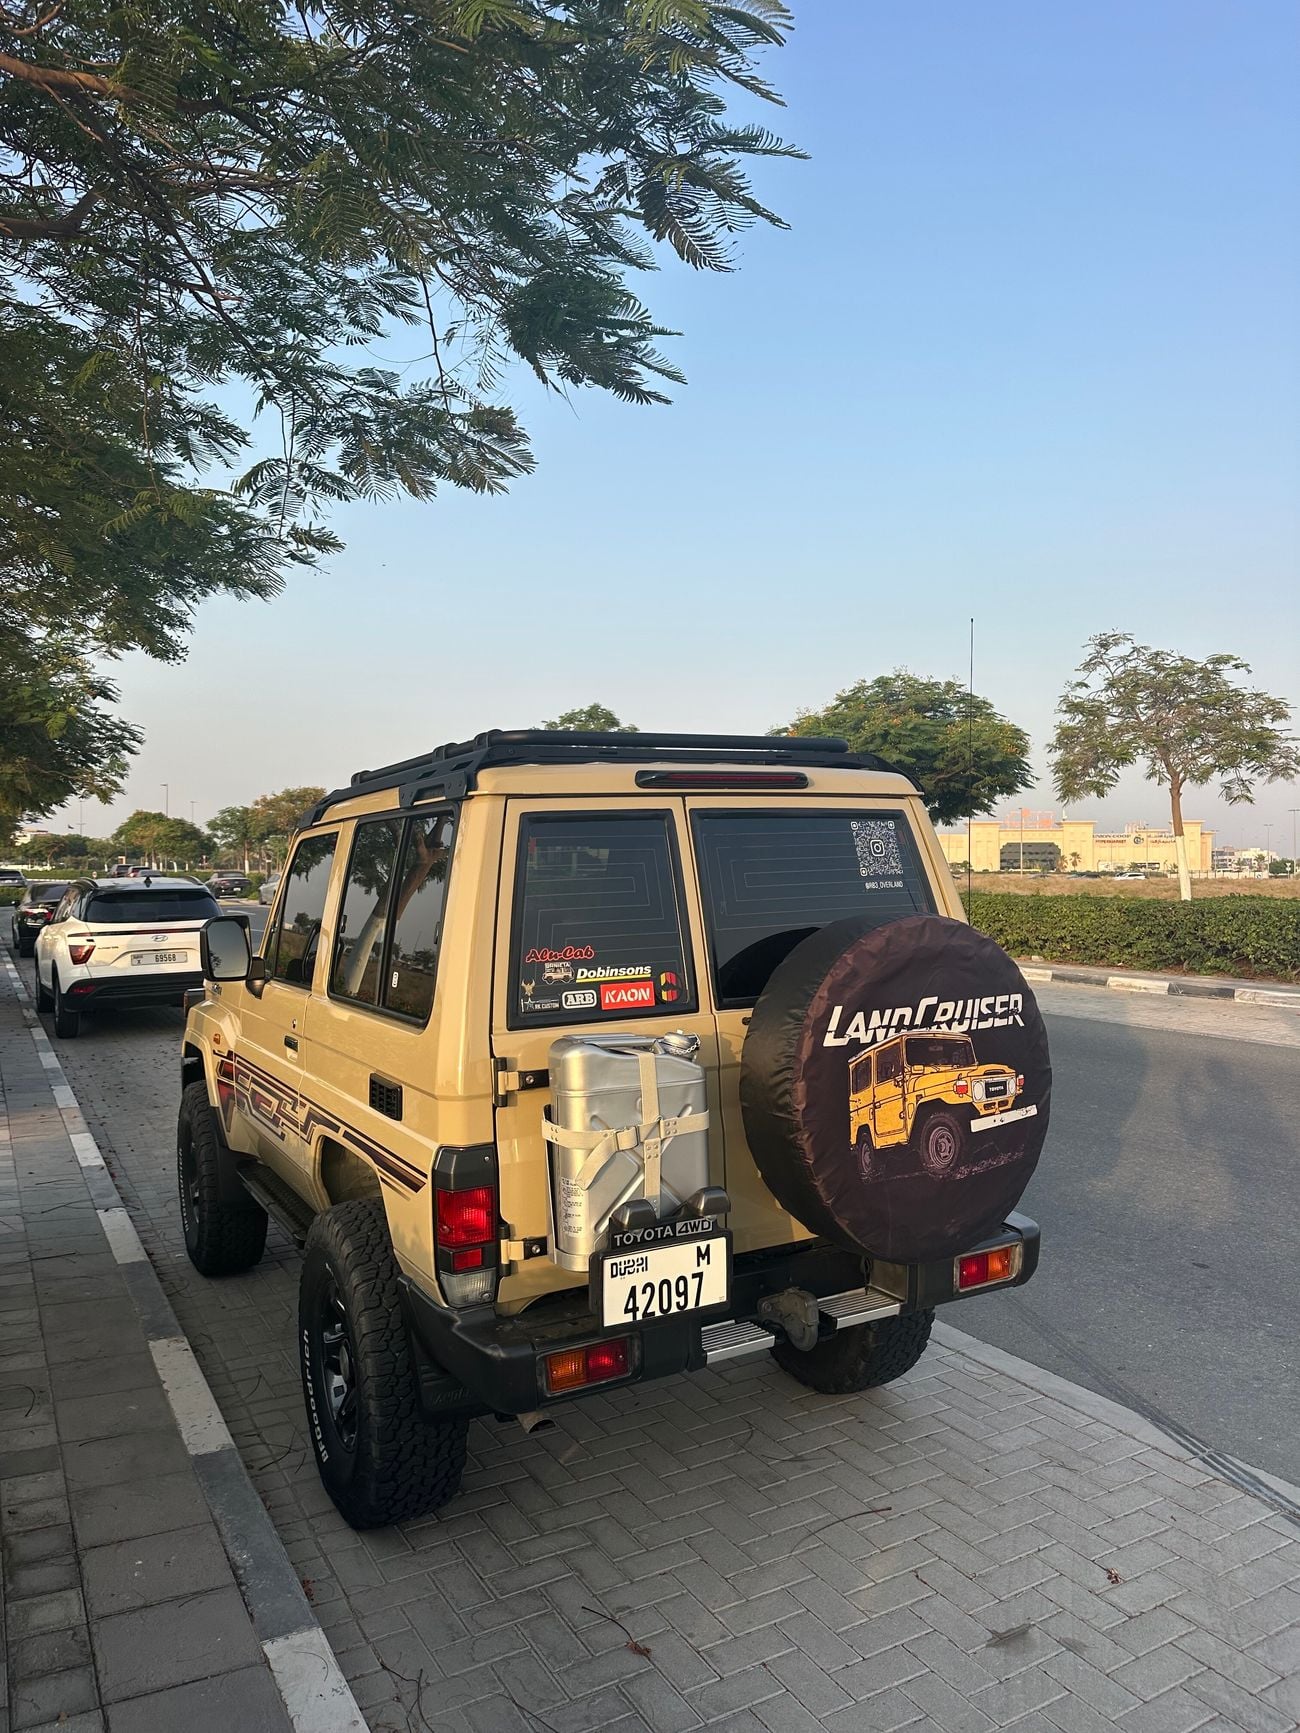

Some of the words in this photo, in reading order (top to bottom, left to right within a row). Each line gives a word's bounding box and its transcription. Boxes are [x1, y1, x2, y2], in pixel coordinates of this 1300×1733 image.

[526, 946, 594, 962] Alu-Cab
[577, 965, 652, 979] Dobinsons
[566, 993, 594, 1005] ARB
[605, 987, 650, 1004] KAON
[614, 1226, 673, 1247] TOYOTA
[677, 1219, 712, 1235] 4WD
[696, 1243, 711, 1267] M
[624, 1272, 703, 1320] 42097
